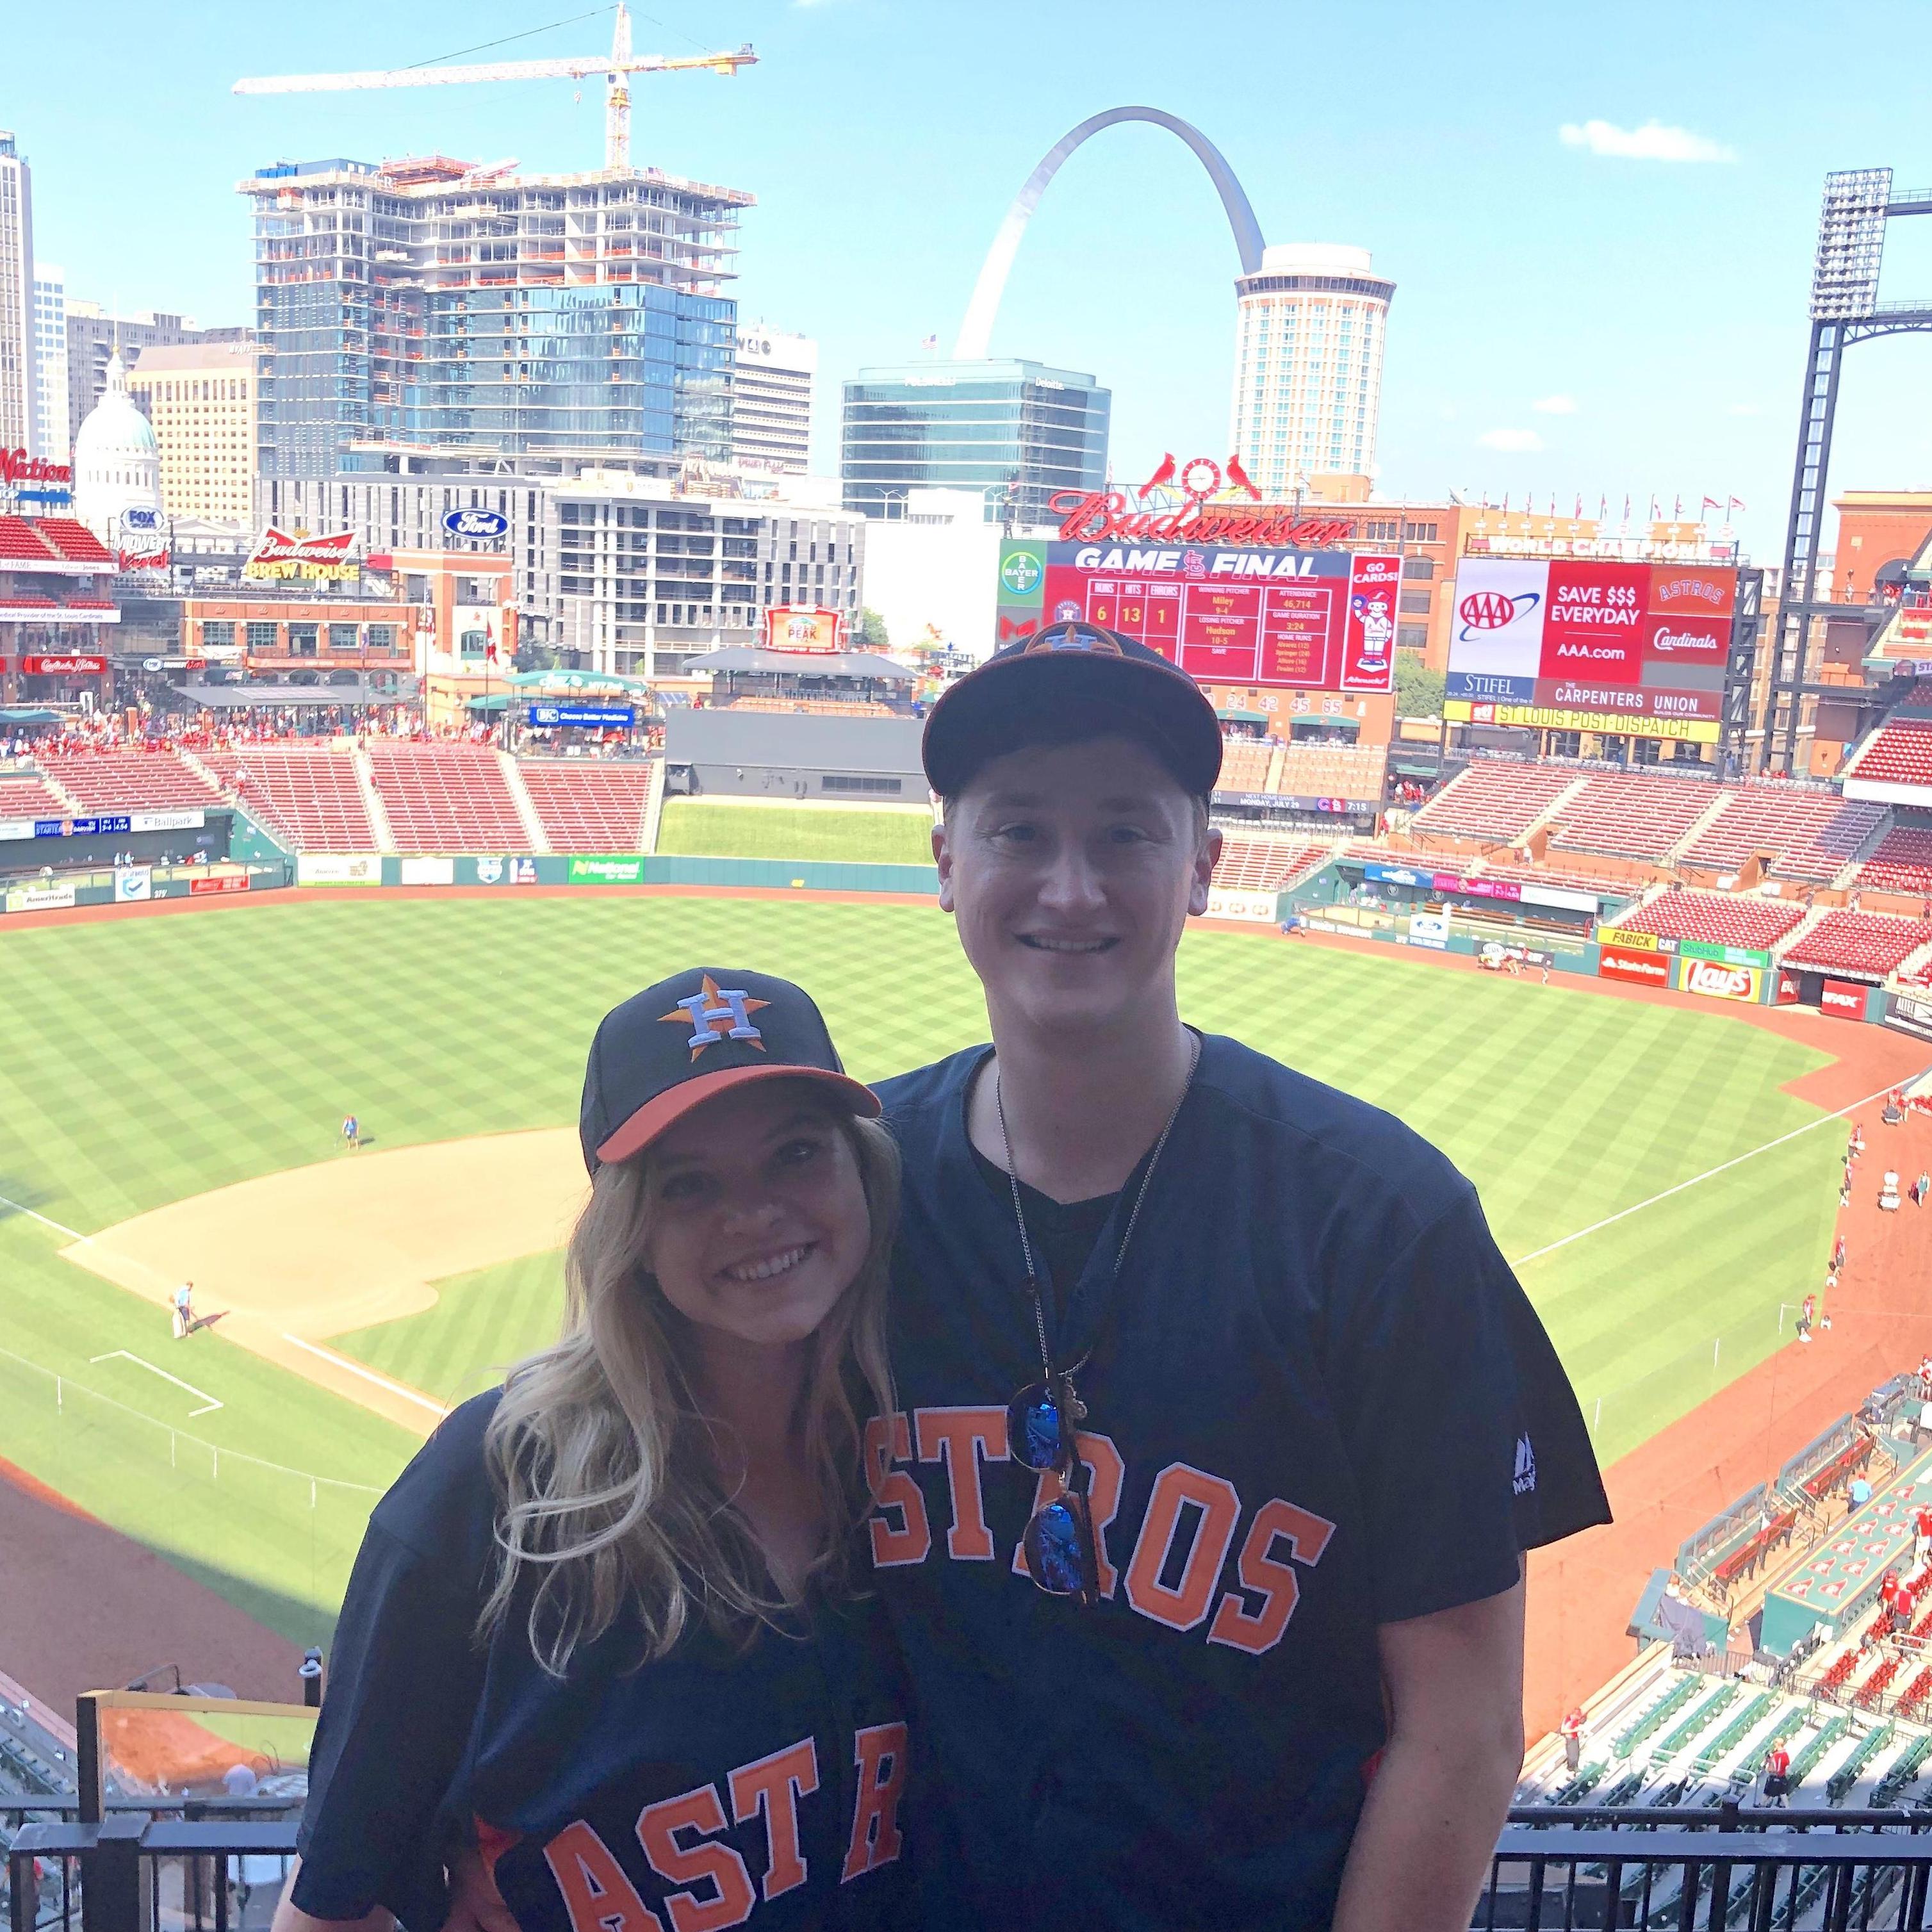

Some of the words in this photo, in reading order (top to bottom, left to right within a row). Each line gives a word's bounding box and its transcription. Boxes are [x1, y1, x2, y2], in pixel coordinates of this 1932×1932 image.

[129, 511, 156, 523] FOX
[457, 512, 499, 534] Ford
[1049, 490, 1356, 546] Budweiser
[256, 536, 359, 559] Budweiser
[1489, 537, 1568, 556] WORLD
[247, 562, 298, 579] BREW
[302, 564, 360, 581] HOUSE
[1076, 548, 1182, 577] GAME
[1209, 552, 1320, 582] FINAL
[1366, 562, 1385, 572] GO
[1354, 572, 1398, 584] CARDS!
[1095, 584, 1114, 593] RUNS
[1125, 584, 1142, 594] HITS
[1150, 585, 1178, 596] ERRORS
[1557, 586, 1601, 604] SAVE
[1607, 585, 1635, 607] $$$
[1658, 580, 1725, 605] ASTROS
[1213, 596, 1234, 605] Miley
[1283, 600, 1311, 609] 46,714
[1097, 607, 1107, 621] 6
[1122, 607, 1140, 622] 13
[1158, 609, 1165, 623] 1
[1466, 593, 1509, 628] AAA
[1551, 605, 1640, 626] EVERYDAY
[1206, 626, 1236, 635] Hudson
[1286, 622, 1304, 630] 3:24
[789, 629, 817, 639] PEAK
[1654, 627, 1718, 650] Cardinals
[1557, 643, 1625, 660] AAA.com
[1464, 675, 1514, 694] STIFEL
[1226, 695, 1247, 710] 24
[1258, 696, 1279, 712] 42
[1289, 698, 1311, 713] 45
[1322, 700, 1343, 714] 85
[1555, 687, 1643, 708] CARPENTERS
[1654, 695, 1698, 712] UNION
[540, 710, 557, 721] BJC
[1500, 706, 1519, 722] ST.
[1523, 707, 1564, 726] LOUIS
[1571, 712, 1689, 737] POST-DISPATCH
[1240, 798, 1272, 807] MONDAY,
[1272, 799, 1289, 808] JULY
[1347, 801, 1366, 812] 7:15
[154, 816, 192, 827] Ballpark
[589, 860, 640, 874] National
[1612, 932, 1651, 947] FABICK
[1658, 938, 1678, 951] CAT
[1683, 944, 1719, 957] StubHub
[1689, 960, 1749, 994] Lay's
[676, 988, 762, 1048] H
[865, 1405, 1336, 1655] STROS
[543, 1721, 907, 1932] ASTR
